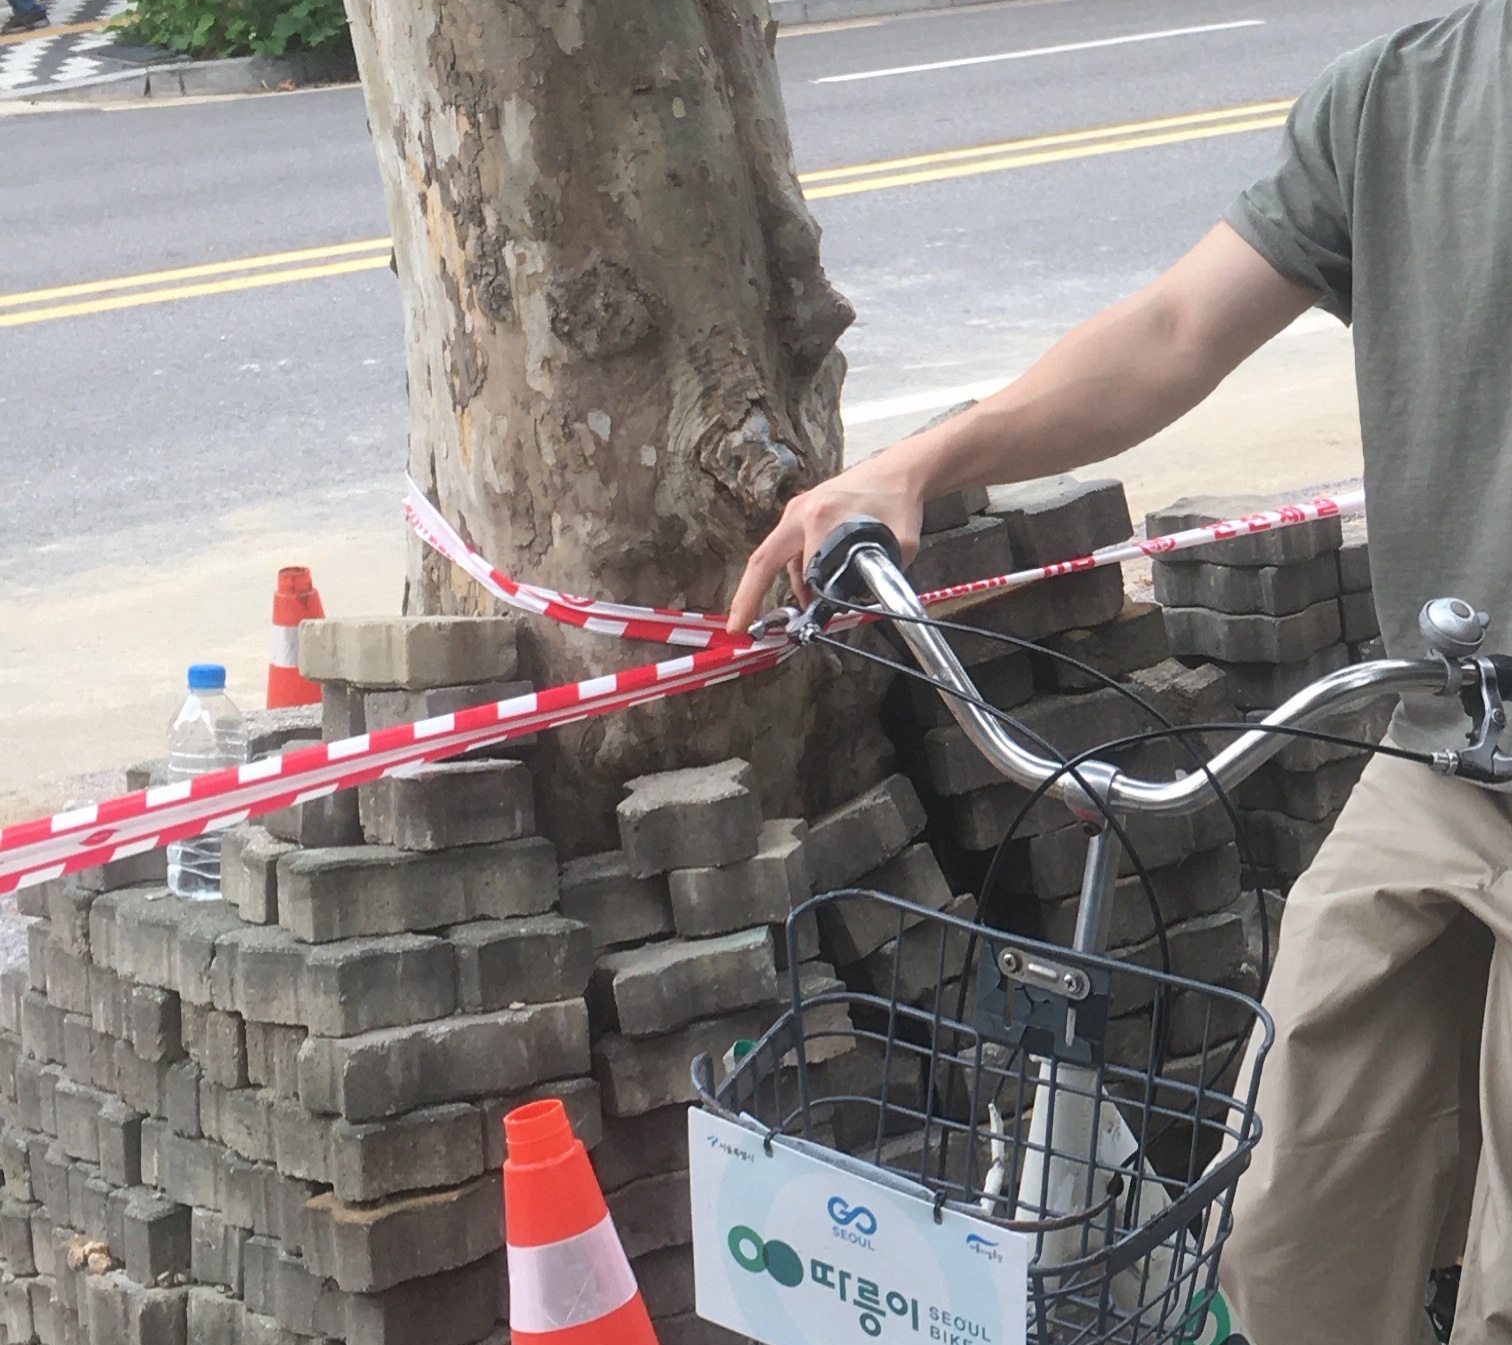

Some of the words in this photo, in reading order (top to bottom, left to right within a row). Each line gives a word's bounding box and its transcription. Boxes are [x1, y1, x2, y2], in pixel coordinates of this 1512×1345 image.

[832, 1226, 875, 1251] SEOUL
[811, 1258, 919, 1337] 따릉이
[929, 1306, 991, 1342] SEOUL
